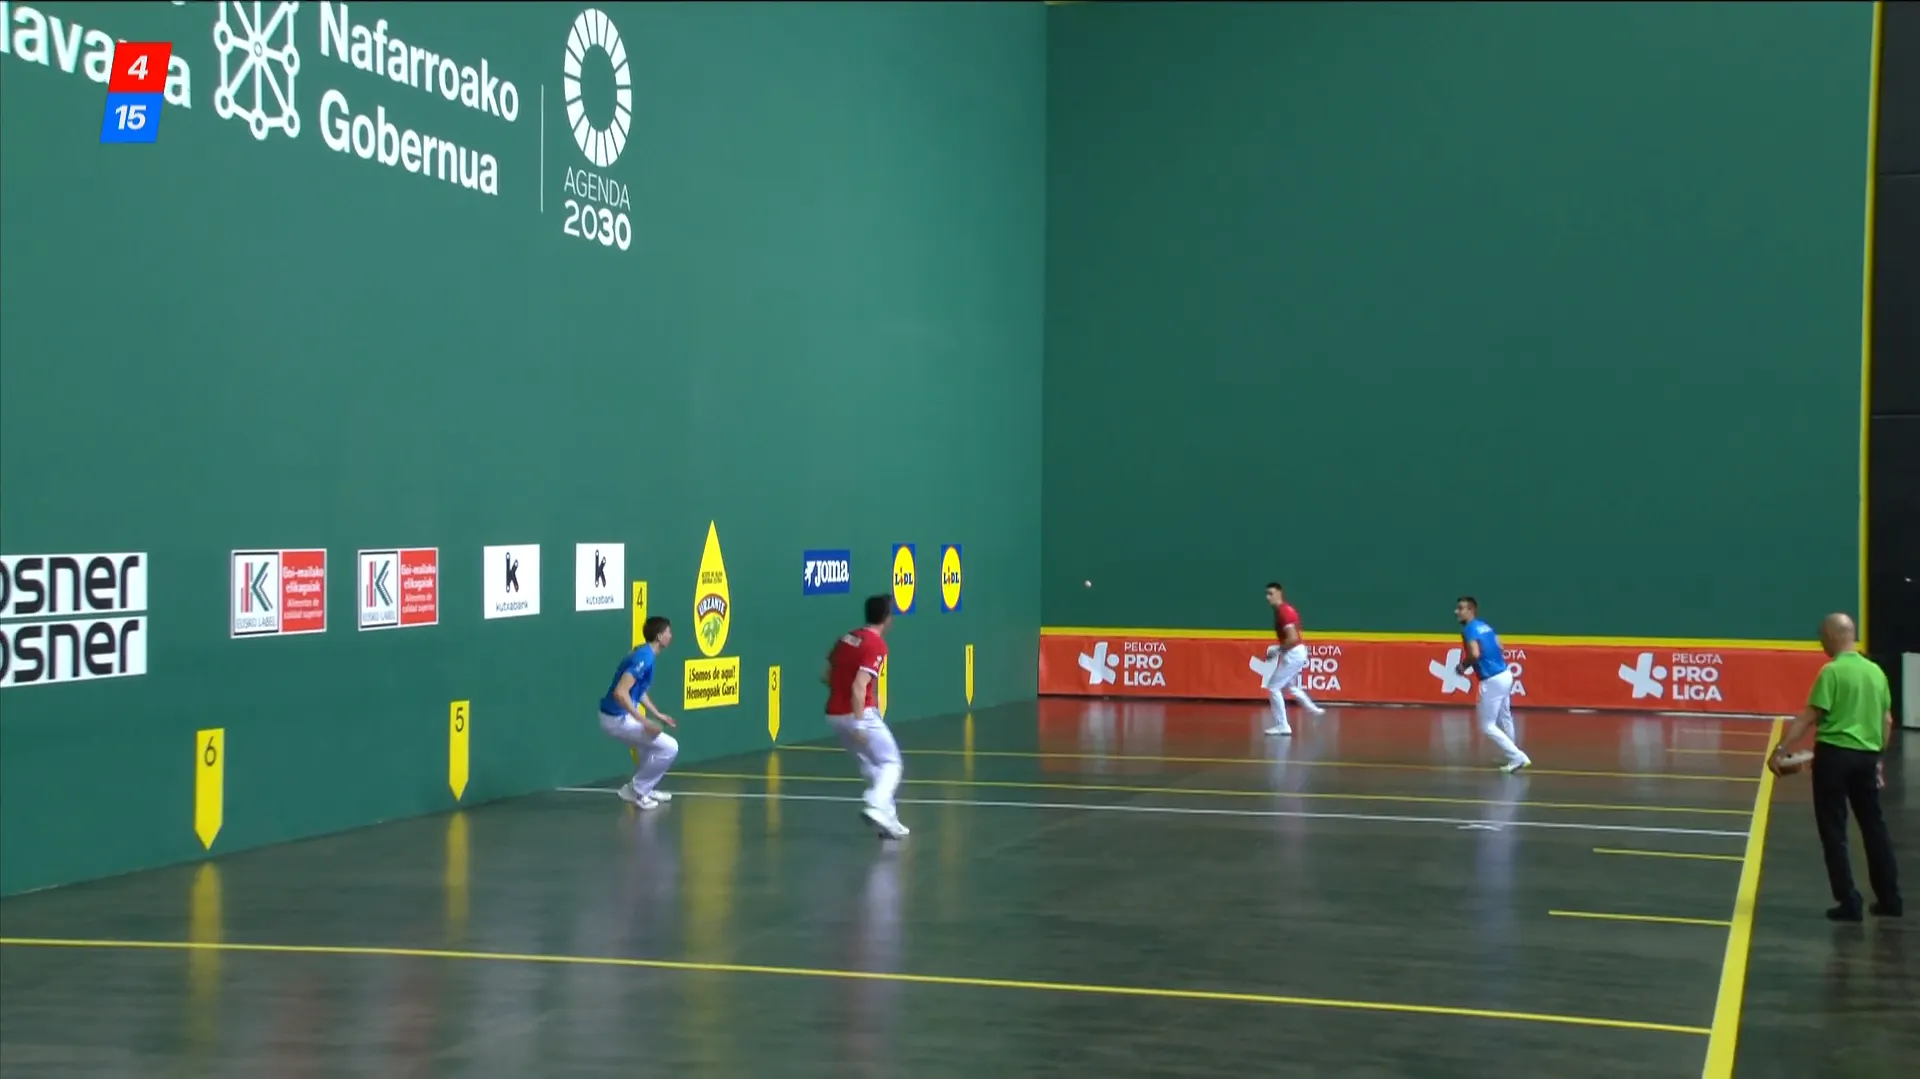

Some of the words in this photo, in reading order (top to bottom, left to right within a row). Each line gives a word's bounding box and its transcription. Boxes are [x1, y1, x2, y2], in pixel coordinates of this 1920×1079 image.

[320, 2, 519, 122] Nafarroako
[319, 88, 498, 196] Gobernua
[564, 166, 631, 211] AGENDA
[564, 199, 632, 251] 2030
[496, 601, 528, 612] kutxabank
[586, 594, 614, 605] kutxabank
[637, 588, 643, 609] 4
[1124, 641, 1166, 652] PELOTA
[1305, 645, 1341, 656] ELOTA
[1503, 649, 1526, 660] OTA
[1124, 654, 1163, 669] PRO
[1672, 653, 1723, 664] PELOTA
[713, 666, 720, 680] de
[771, 671, 777, 691] 3
[1124, 670, 1166, 686] LIGA
[1672, 666, 1718, 682] PRO
[1297, 674, 1341, 691] LIGA
[1672, 683, 1722, 701] LIGA
[455, 707, 464, 732] 5
[204, 736, 217, 767] 6
